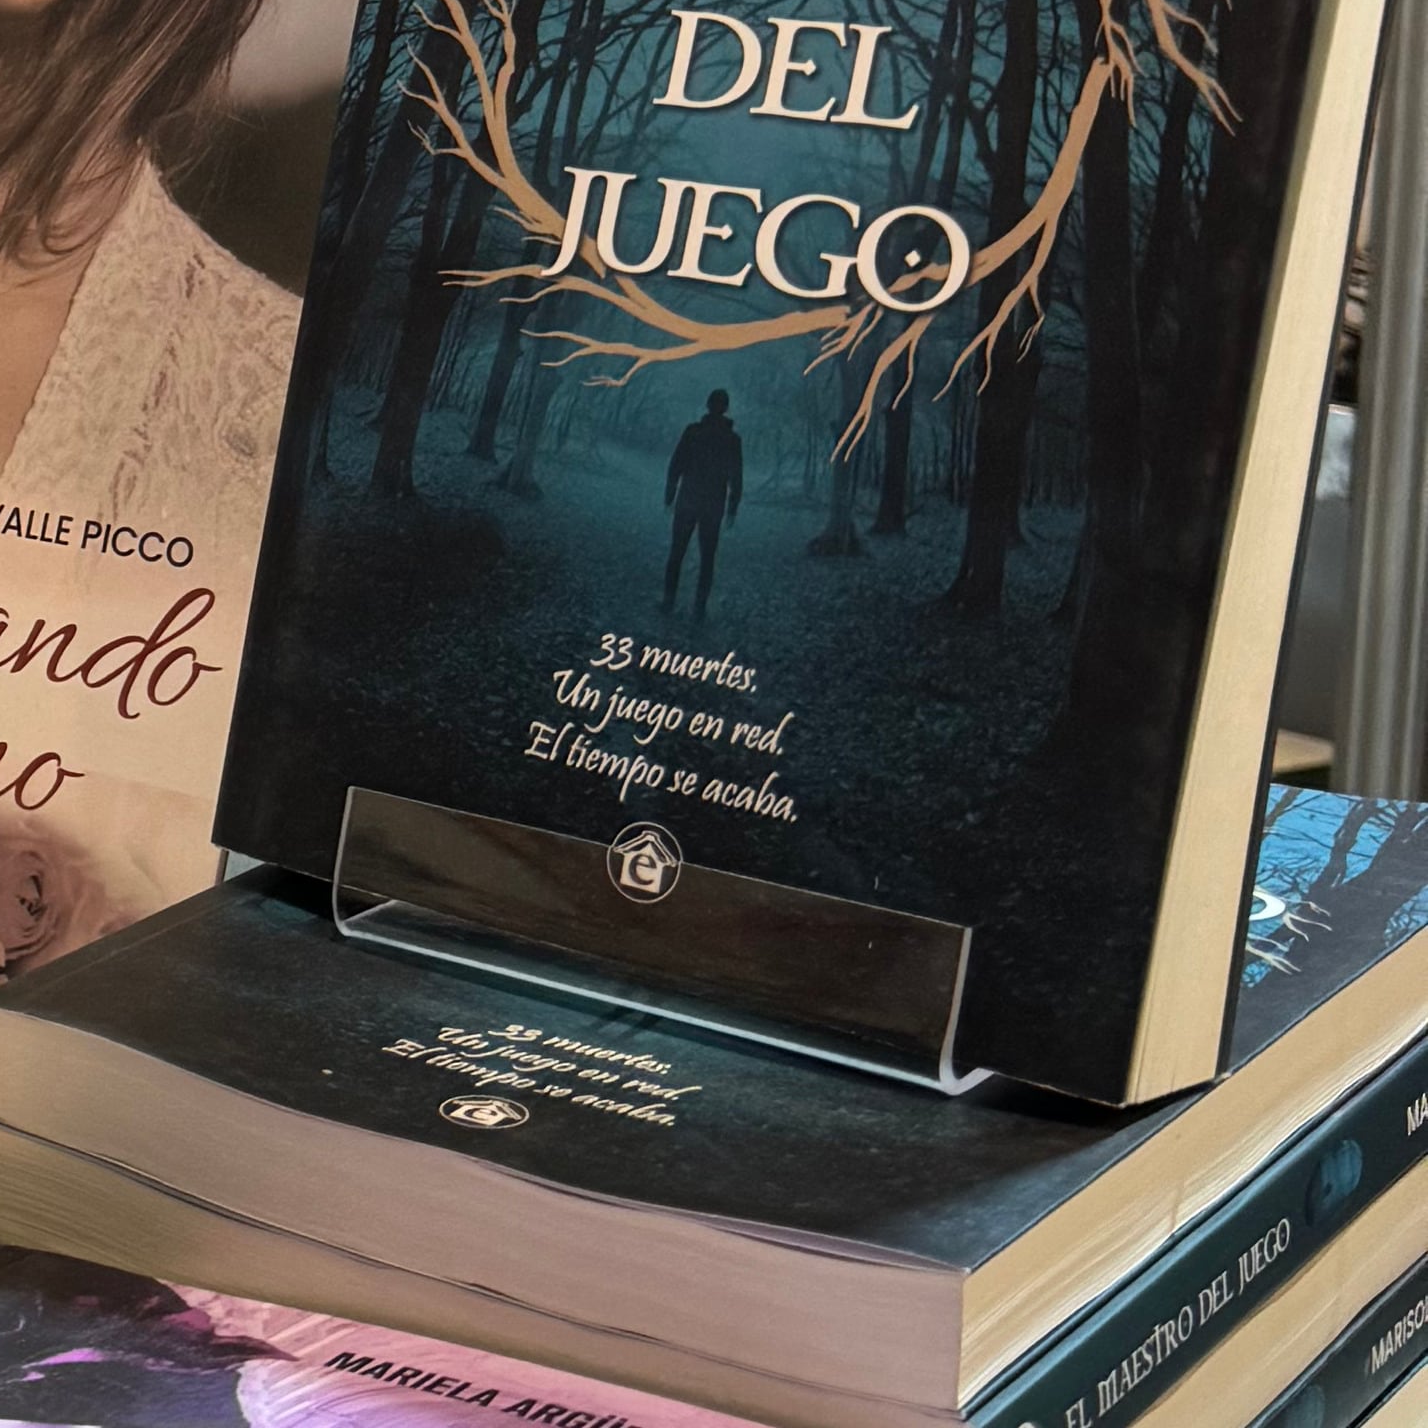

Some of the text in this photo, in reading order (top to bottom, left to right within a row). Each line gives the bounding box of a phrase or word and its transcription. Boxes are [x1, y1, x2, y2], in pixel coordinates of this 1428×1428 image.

[653, 9, 922, 129] DEL
[541, 166, 970, 313] JUEGO
[80, 522, 196, 570] PICCO
[590, 632, 757, 693] 33 muertes.
[553, 669, 795, 756] Un juego en red.
[524, 721, 797, 823] El tiempo se acaba.
[381, 1038, 677, 1127] El tiempo se acaba.
[438, 1026, 703, 1102] Un juego en red.
[487, 1023, 672, 1075] 33 muertes.
[1064, 1217, 1291, 1428] EL MAESTRO DEL JUEGO
[323, 1350, 501, 1409] MARIELA
